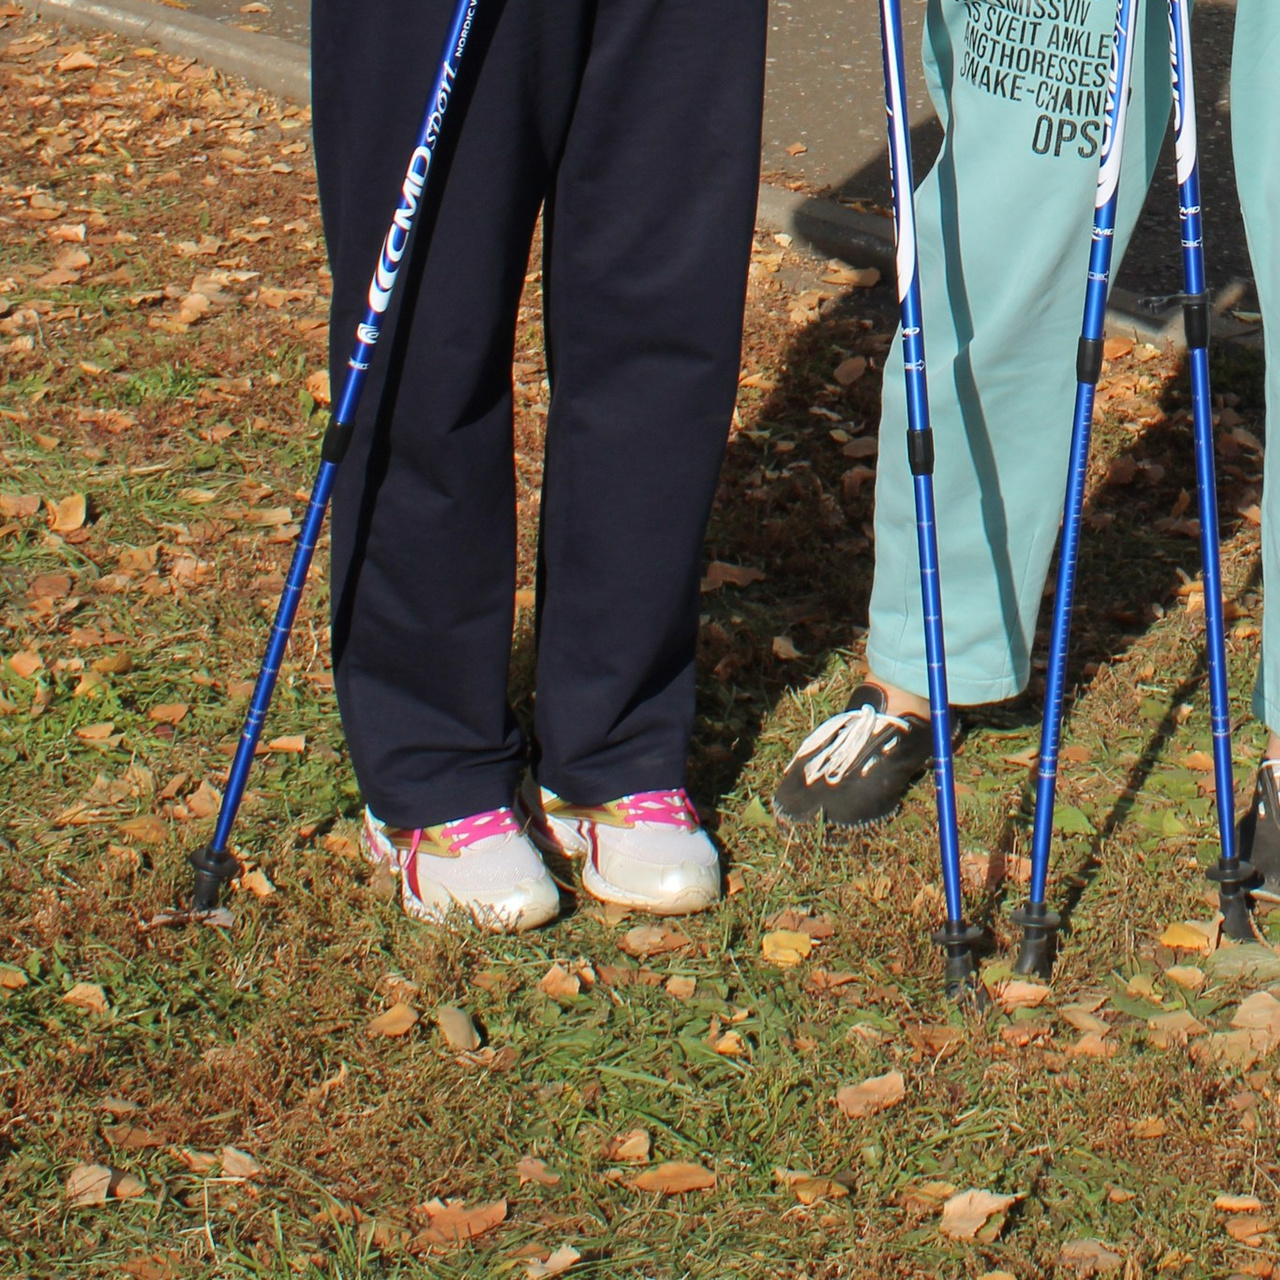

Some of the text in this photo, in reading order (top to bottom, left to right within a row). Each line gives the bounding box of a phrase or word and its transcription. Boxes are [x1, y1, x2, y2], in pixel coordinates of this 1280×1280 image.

[455, 7, 475, 58] NORDIC
[1047, 24, 1112, 59] ANKLE
[1032, 114, 1100, 158] OPS
